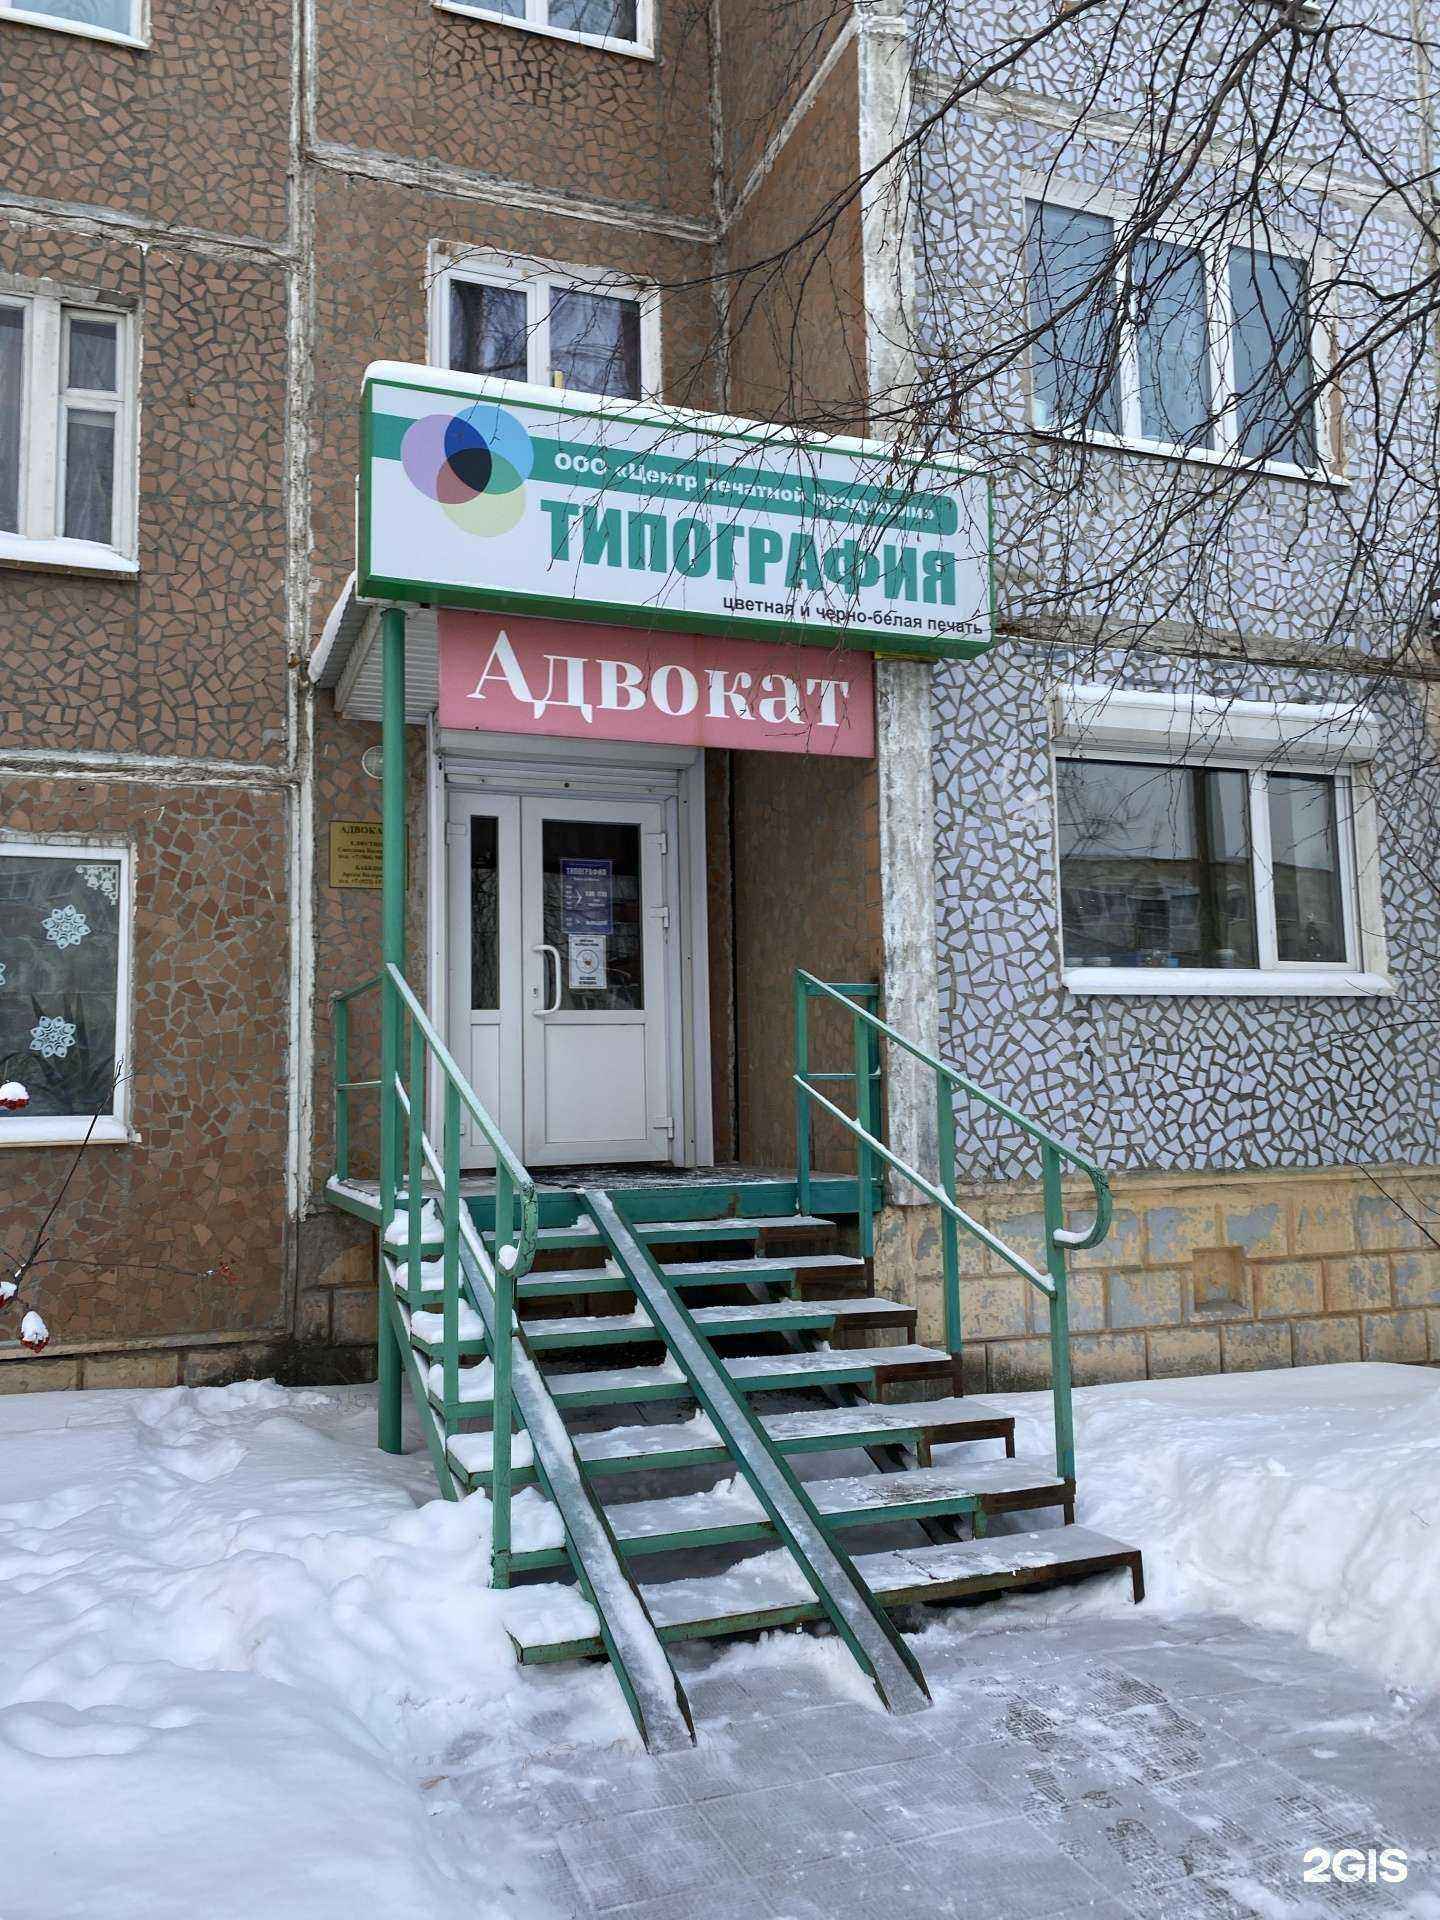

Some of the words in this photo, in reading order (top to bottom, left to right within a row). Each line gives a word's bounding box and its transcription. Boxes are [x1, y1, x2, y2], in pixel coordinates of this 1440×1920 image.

[554, 452, 607, 475] ООО
[615, 462, 697, 492] «Центр
[704, 478, 806, 503] печатной
[540, 499, 956, 605] ТИПОГРАФИЯ
[723, 597, 794, 615] цветная
[800, 604, 810, 617] и
[816, 606, 922, 629] черно-белая
[928, 619, 983, 635] печать
[466, 630, 849, 727] Адвокат
